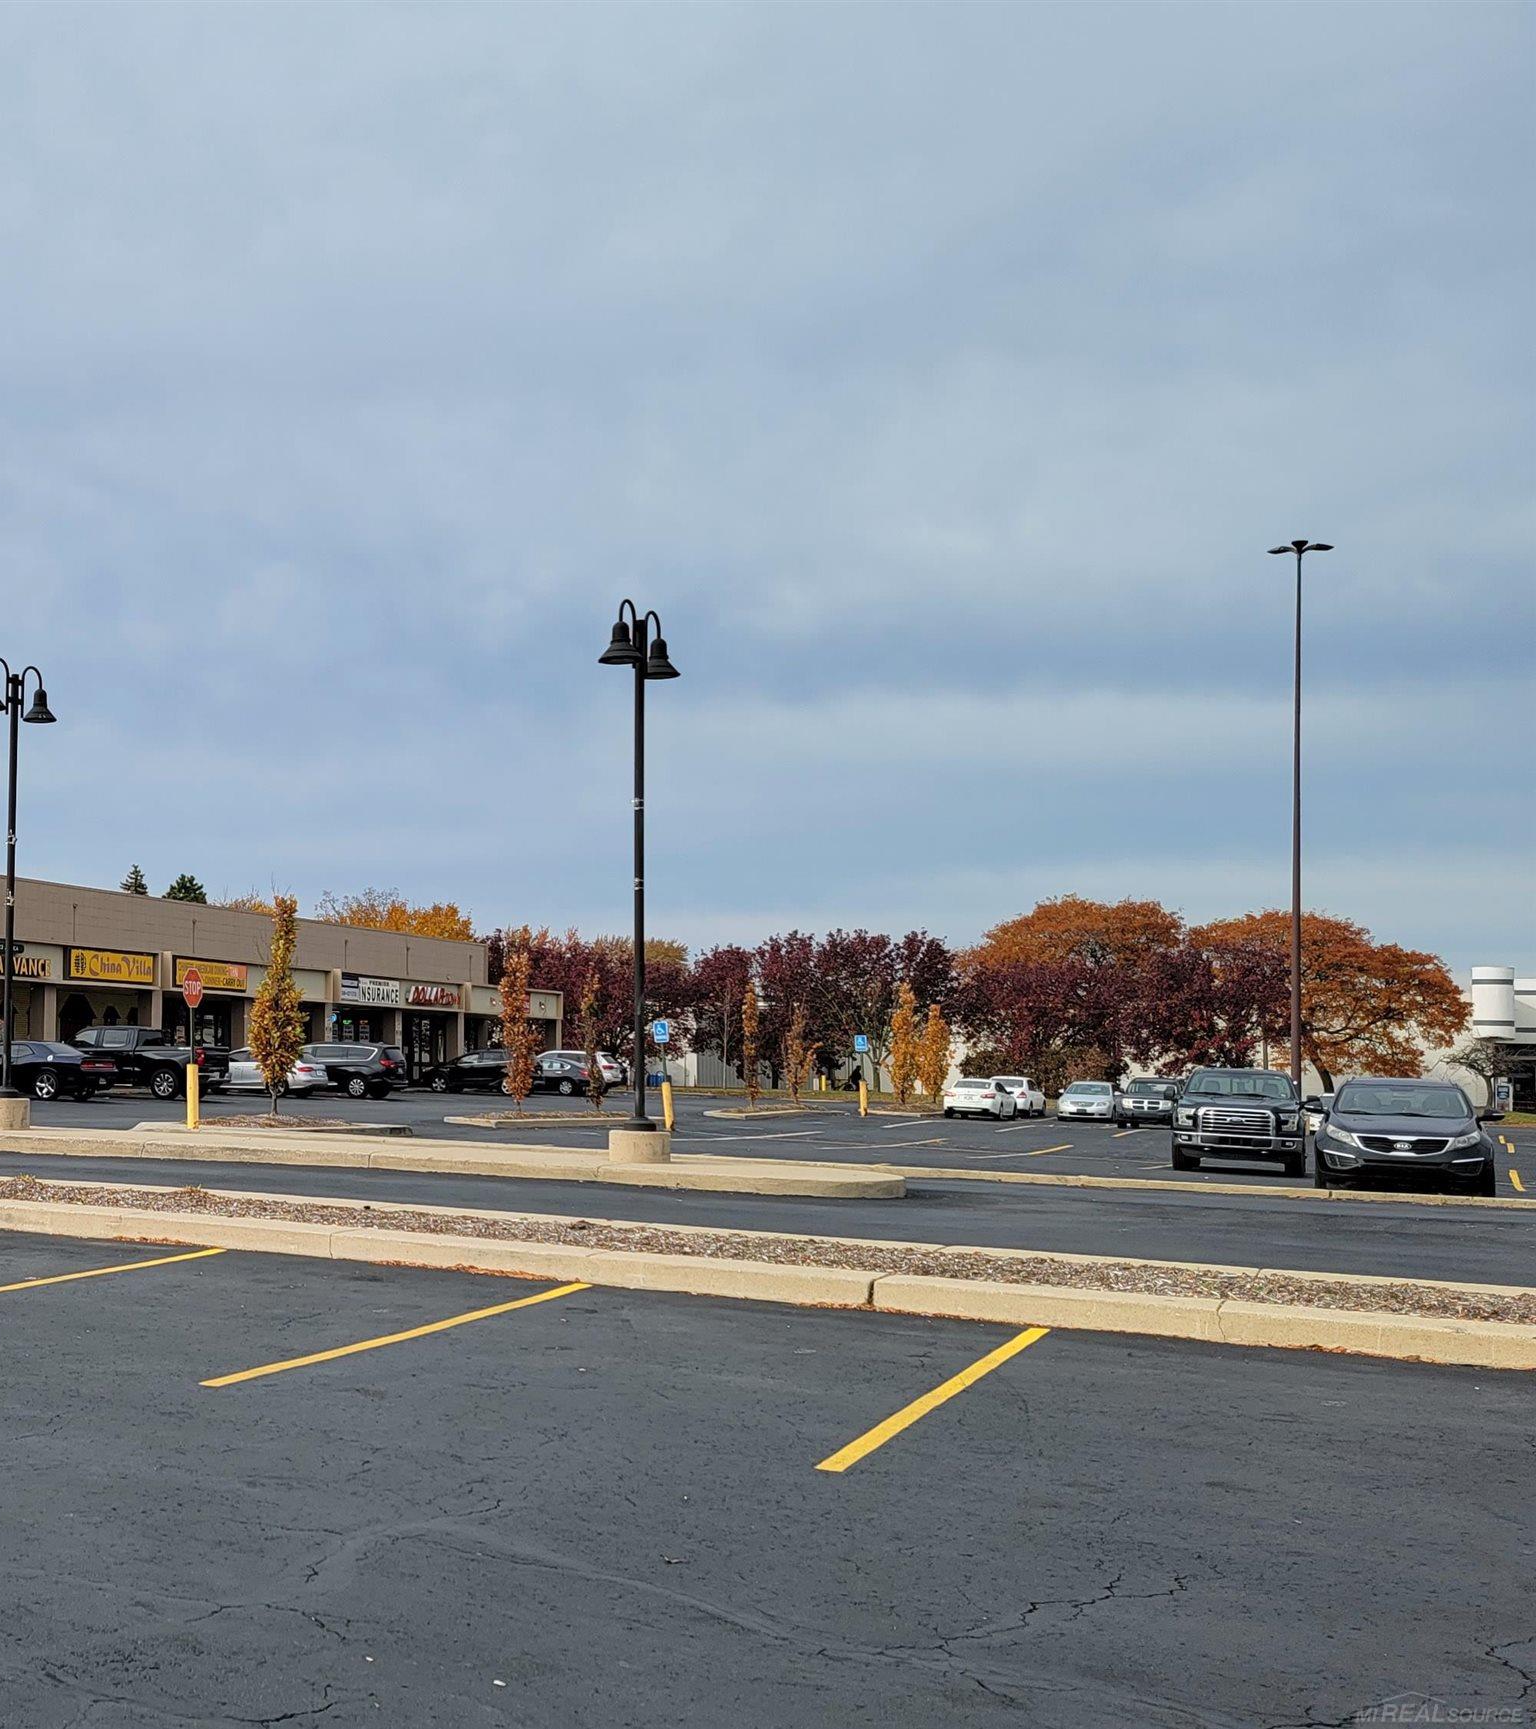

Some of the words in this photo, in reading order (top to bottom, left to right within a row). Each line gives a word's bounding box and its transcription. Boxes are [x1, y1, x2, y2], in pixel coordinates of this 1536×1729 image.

[90, 954, 122, 976] China
[121, 955, 152, 978] Villa
[185, 981, 201, 995] STOP
